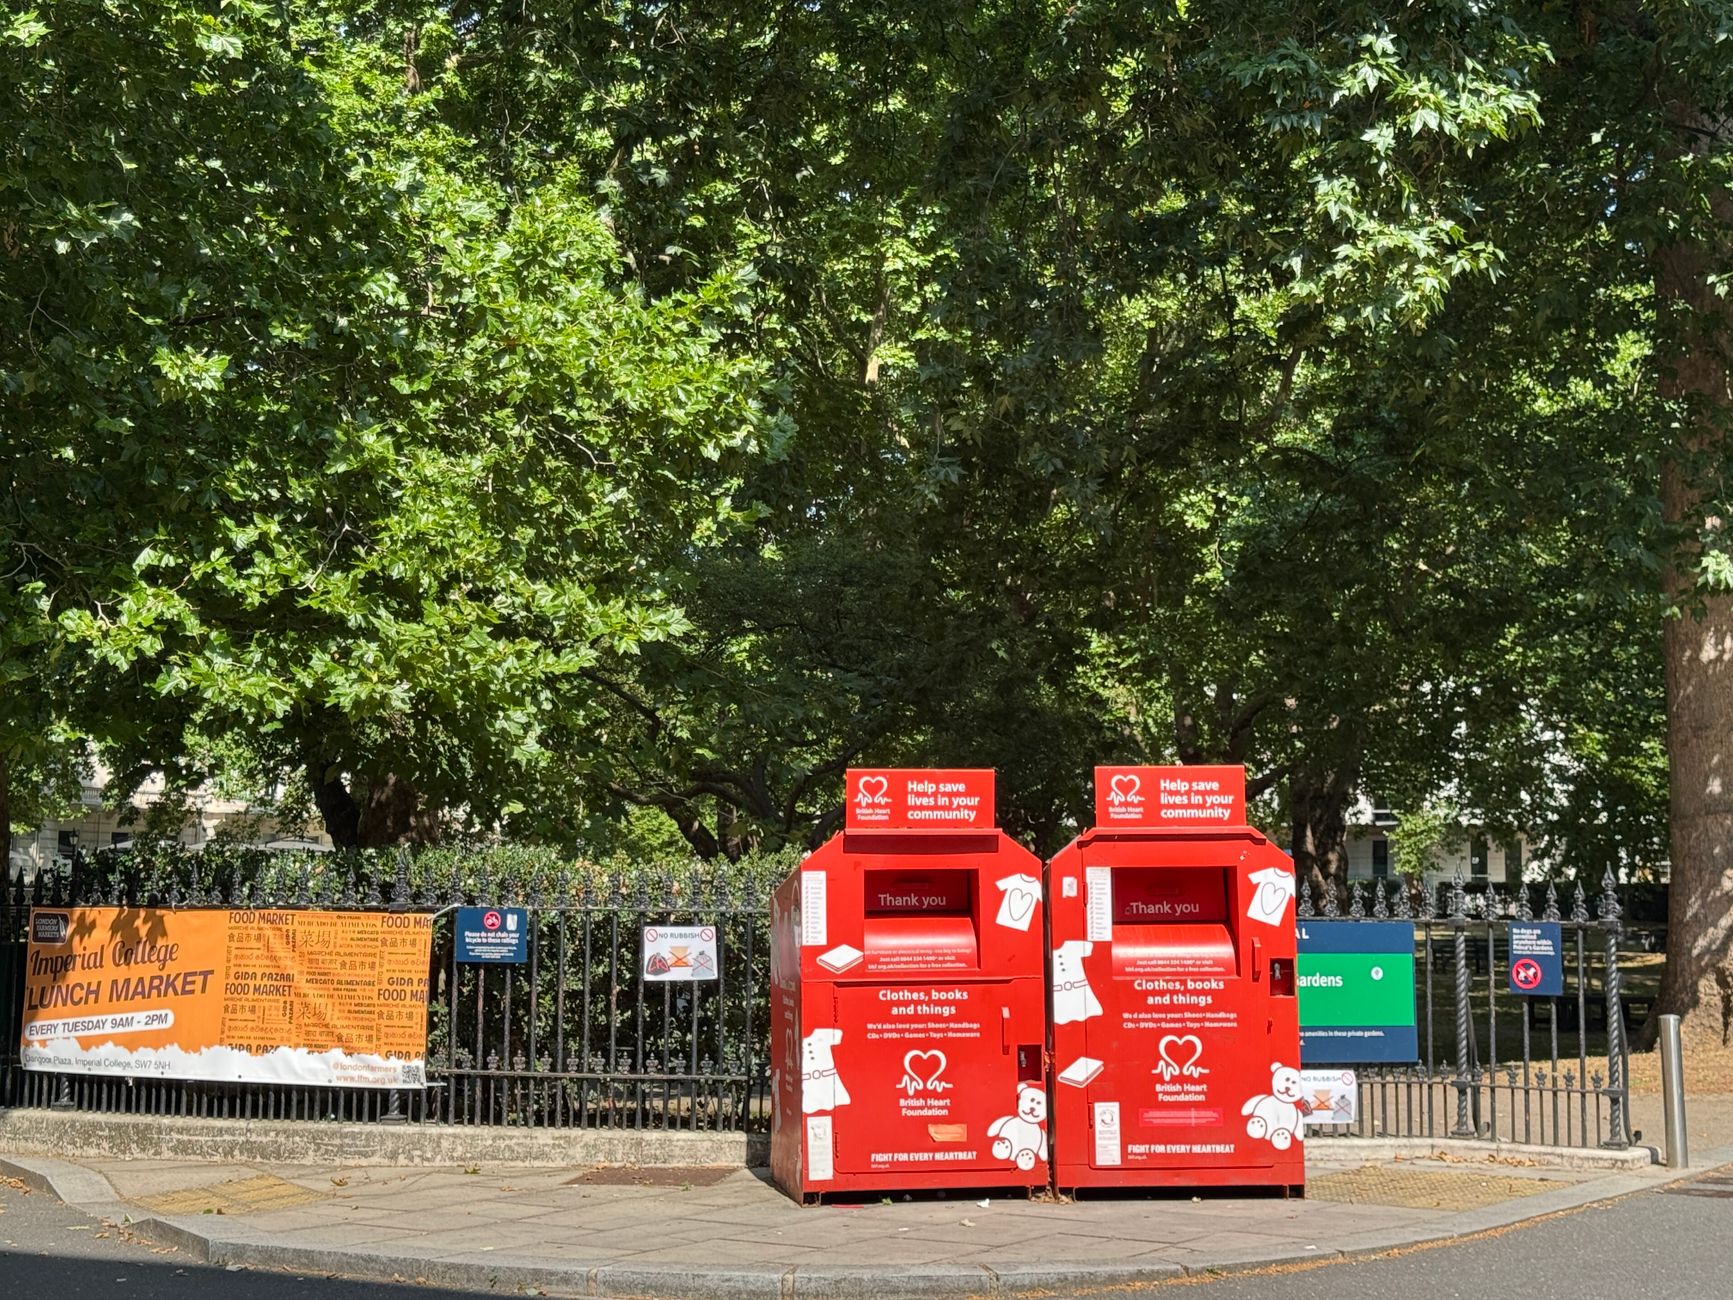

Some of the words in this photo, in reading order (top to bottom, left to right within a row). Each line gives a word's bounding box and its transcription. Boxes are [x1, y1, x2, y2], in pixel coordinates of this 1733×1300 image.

[908, 781, 937, 795] Help
[938, 783, 966, 793] save
[1160, 779, 1189, 794] Help
[1191, 781, 1219, 792] save
[908, 794, 936, 806] lives
[937, 794, 949, 806] in
[951, 797, 980, 809] your
[1160, 793, 1189, 805] lives
[1191, 793, 1203, 805] in
[1205, 796, 1235, 808] your
[874, 807, 891, 815] Heart
[907, 808, 977, 823] community
[1160, 806, 1231, 821] community
[878, 893, 919, 907] Thank
[921, 896, 947, 910] you
[1129, 901, 1172, 915] Thank
[1174, 903, 1200, 917] you
[229, 911, 256, 924] FOOD
[258, 912, 297, 926] MARKET
[381, 916, 410, 929] FOOD
[658, 932, 669, 940] NO
[669, 932, 700, 940] RUBBISH
[31, 945, 105, 983] Imperial
[111, 938, 180, 971] College
[233, 971, 258, 982] GIDA
[260, 972, 295, 984] PAZARI
[305, 977, 335, 986] MERCATO
[336, 979, 376, 987] ALIMENTARE
[387, 976, 414, 988] GIDA
[1297, 972, 1343, 987] ardens
[27, 980, 102, 1011] LUNCH
[108, 969, 214, 1004] MARKET
[224, 983, 250, 996] FOOD
[252, 984, 293, 998] MARKET
[1134, 979, 1184, 991] Clothes,
[1187, 978, 1225, 990] books
[377, 988, 407, 1001] FOOD
[878, 989, 929, 1002] Clothes,
[931, 988, 969, 1000] books
[1147, 993, 1171, 1005] and
[1172, 992, 1213, 1007] things
[891, 1003, 915, 1015] and
[916, 1003, 957, 1017] things
[1183, 1011, 1203, 1019] Shoes
[1205, 1011, 1238, 1020] Handbags
[29, 1022, 59, 1037] EVERY
[61, 1017, 108, 1033] TUESDAY
[111, 1015, 135, 1029] 9AM
[145, 1012, 169, 1026] 2PM
[927, 1021, 946, 1029] Shoes
[949, 1021, 981, 1030] Handbags
[1139, 1021, 1157, 1029] DVDs
[1161, 1021, 1183, 1029] Games
[1186, 1021, 1201, 1030] Toys
[1204, 1021, 1238, 1029] Homeware
[904, 1031, 926, 1039] Games
[929, 1031, 944, 1040] Toys
[385, 1049, 412, 1061] GIDA
[75, 1057, 103, 1069] Imperial
[104, 1058, 133, 1071] College,
[134, 1059, 153, 1070] SW7
[153, 1060, 171, 1071] 5NH
[332, 1062, 397, 1075] @londonfarmers
[1155, 1083, 1182, 1093] British
[1183, 1083, 1208, 1093] Heart
[899, 1098, 926, 1107] British
[927, 1097, 951, 1107] Heart
[1158, 1092, 1205, 1102] Foundation
[901, 1107, 949, 1117] Foundation
[1127, 1144, 1150, 1154] FIGHT
[1150, 1144, 1166, 1154] FOR
[1166, 1144, 1191, 1154] EVERY
[1191, 1144, 1236, 1154] HEARTBEAT
[871, 1152, 893, 1162] FIGHT
[893, 1152, 909, 1162] FOR
[909, 1151, 934, 1161] EVERY
[934, 1150, 978, 1161] HEARTBEAT
